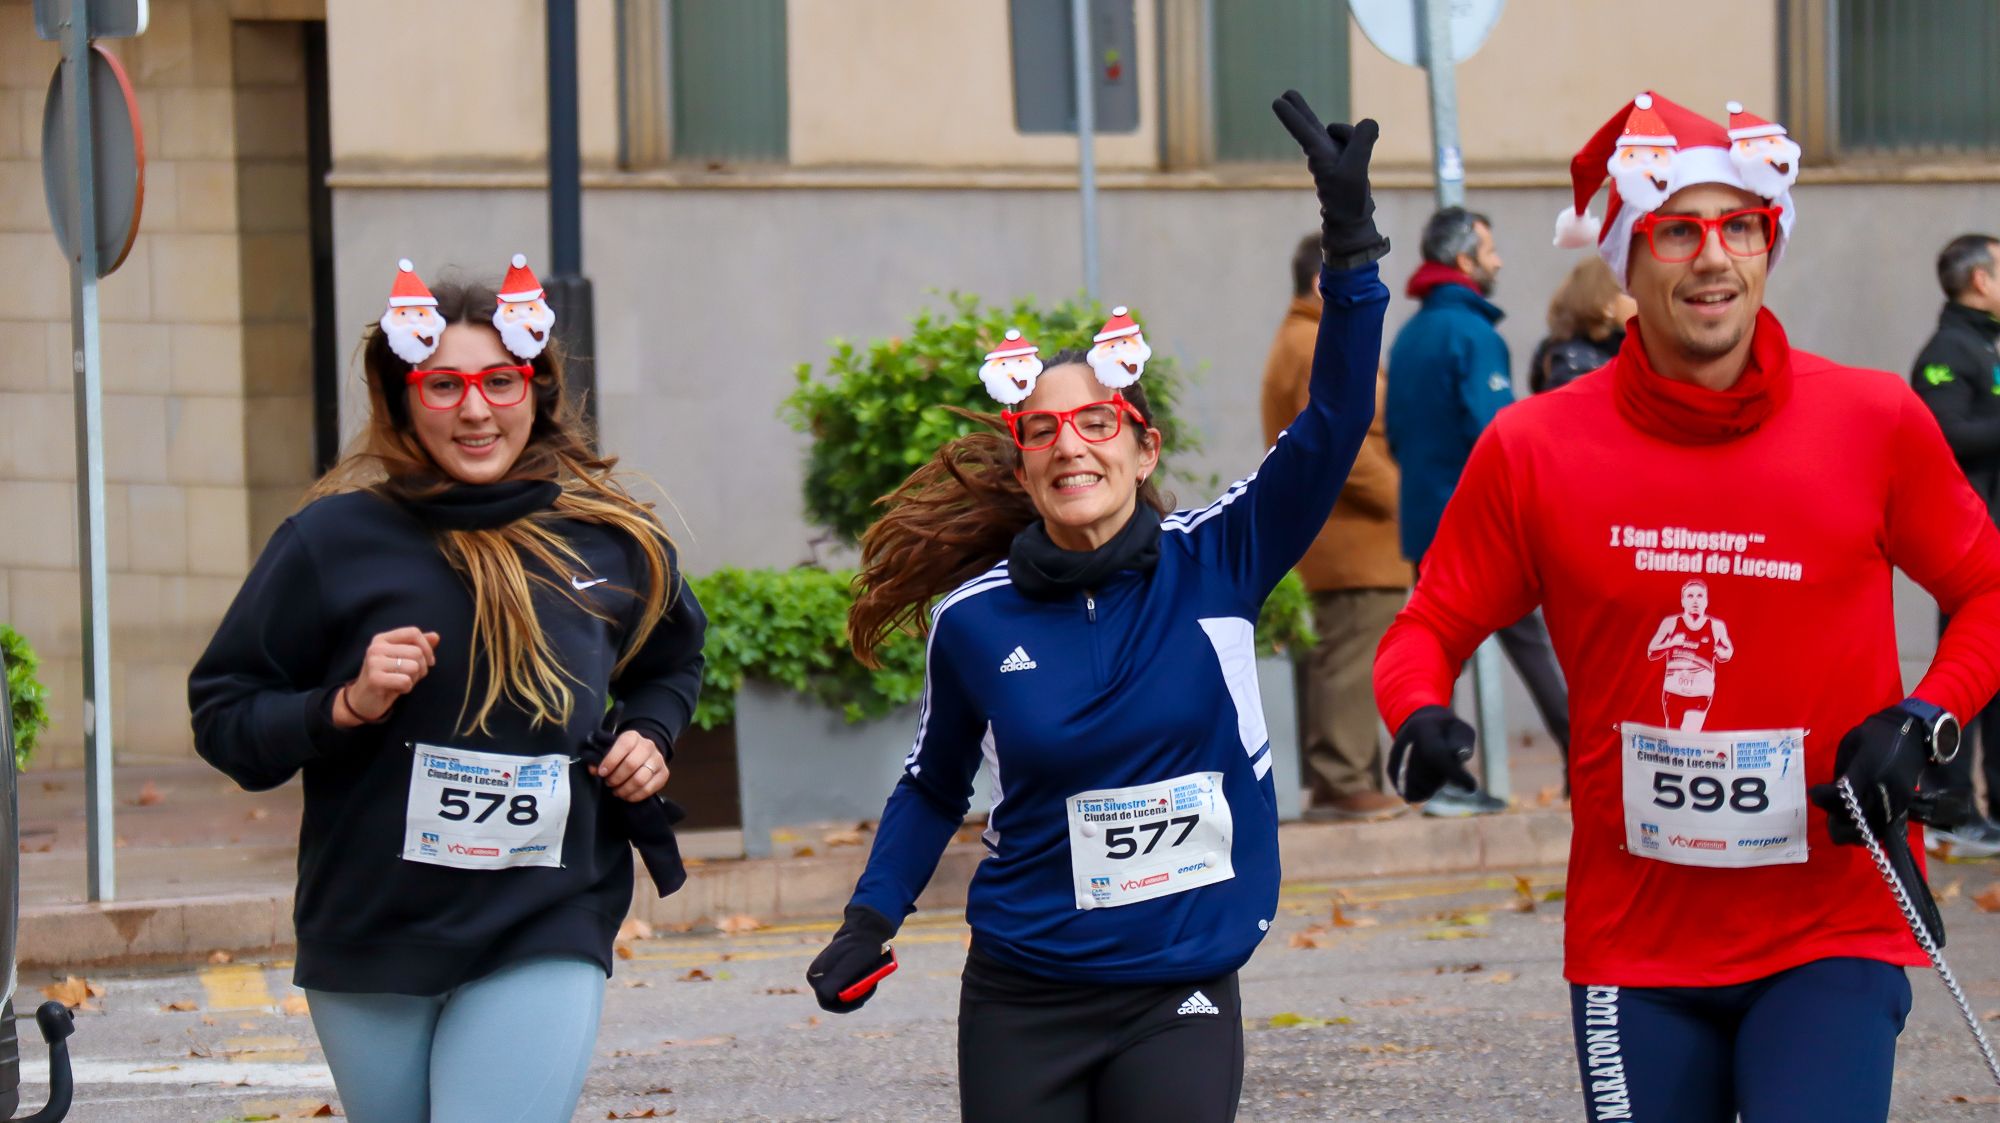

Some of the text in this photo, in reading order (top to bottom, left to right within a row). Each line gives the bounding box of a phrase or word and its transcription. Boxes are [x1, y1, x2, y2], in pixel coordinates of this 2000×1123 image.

[1610, 526, 1620, 547] I
[1623, 526, 1658, 548] San
[1661, 526, 1747, 552] Silvestre
[1635, 549, 1802, 581] Ciudad de Lucena
[1000, 661, 1037, 673] adidas
[1638, 736, 1655, 750] San
[1657, 742, 1701, 757] Silvestre
[430, 758, 447, 770] San
[448, 760, 490, 775] Silvestre
[1637, 751, 1726, 770] Ciudad de Lucena
[427, 769, 459, 782] Ciudad
[460, 772, 473, 783] de
[475, 776, 509, 787] Lucena
[1653, 771, 1769, 814] 598
[438, 787, 539, 826] 578
[1084, 802, 1101, 812] San
[1103, 799, 1146, 812] Silvestre
[1084, 806, 1167, 822] Ciudad de Lucena
[1106, 814, 1199, 860] 577
[1738, 837, 1787, 848] enerplus
[1177, 1005, 1219, 1015] adidas
[1586, 1029, 1632, 1120] MARATON
